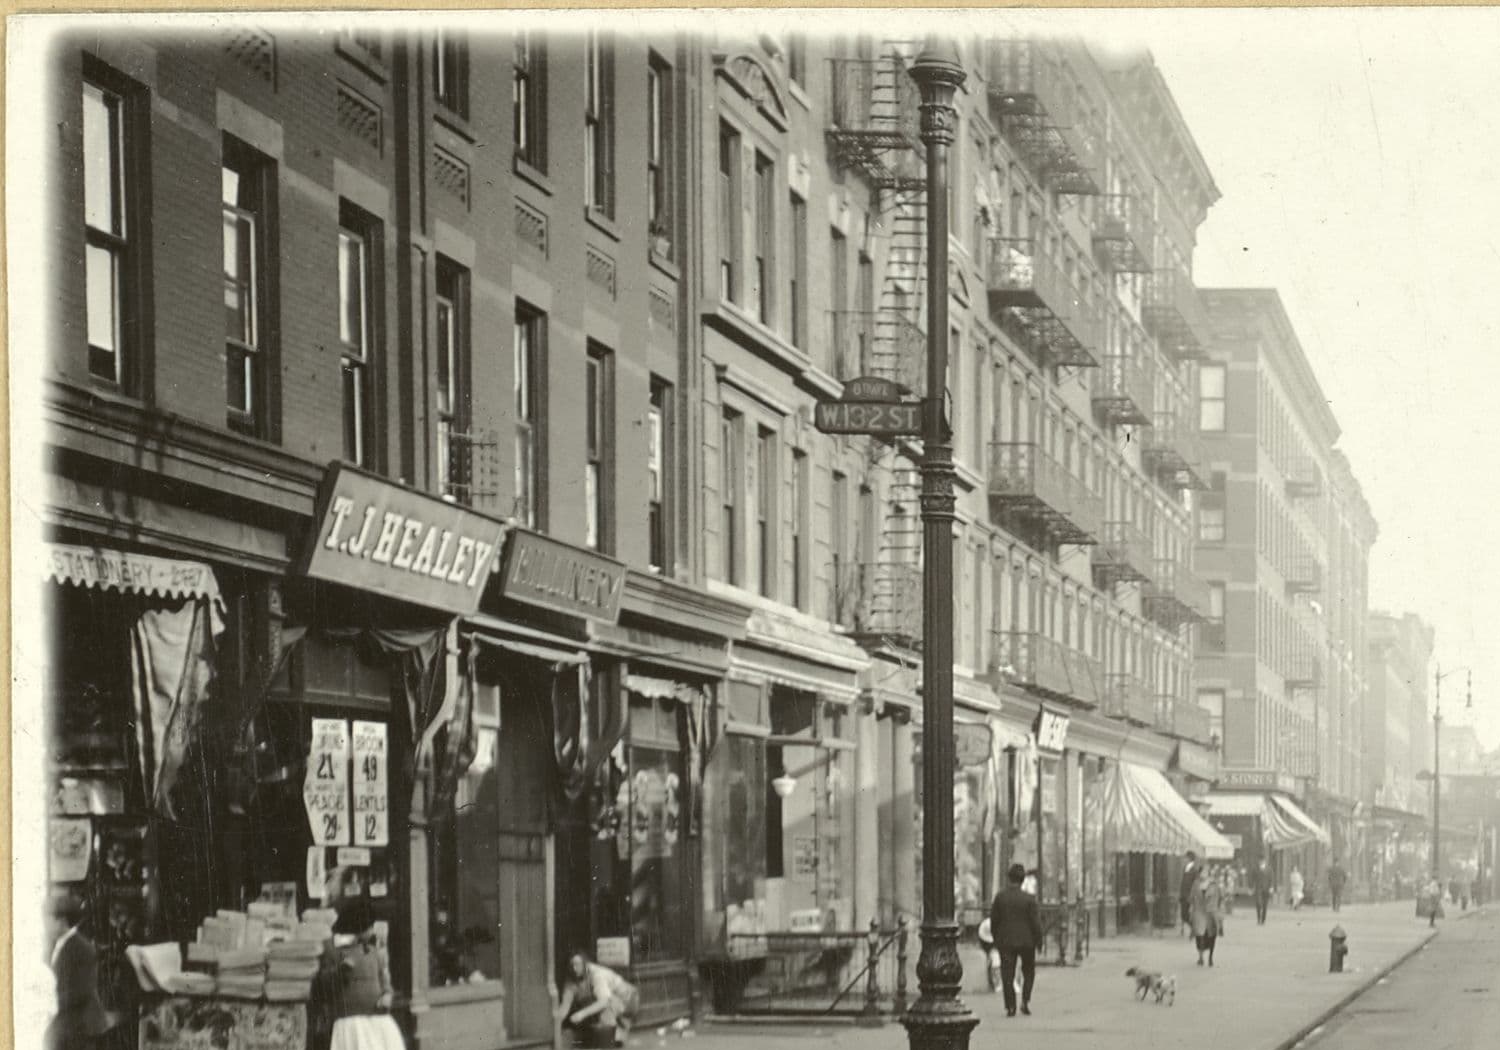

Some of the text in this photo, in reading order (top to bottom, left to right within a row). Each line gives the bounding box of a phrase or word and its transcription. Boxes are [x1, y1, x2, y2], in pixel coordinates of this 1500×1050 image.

[843, 403, 883, 429] 132
[372, 511, 492, 588] HEALEY
[365, 814, 377, 841] 12
